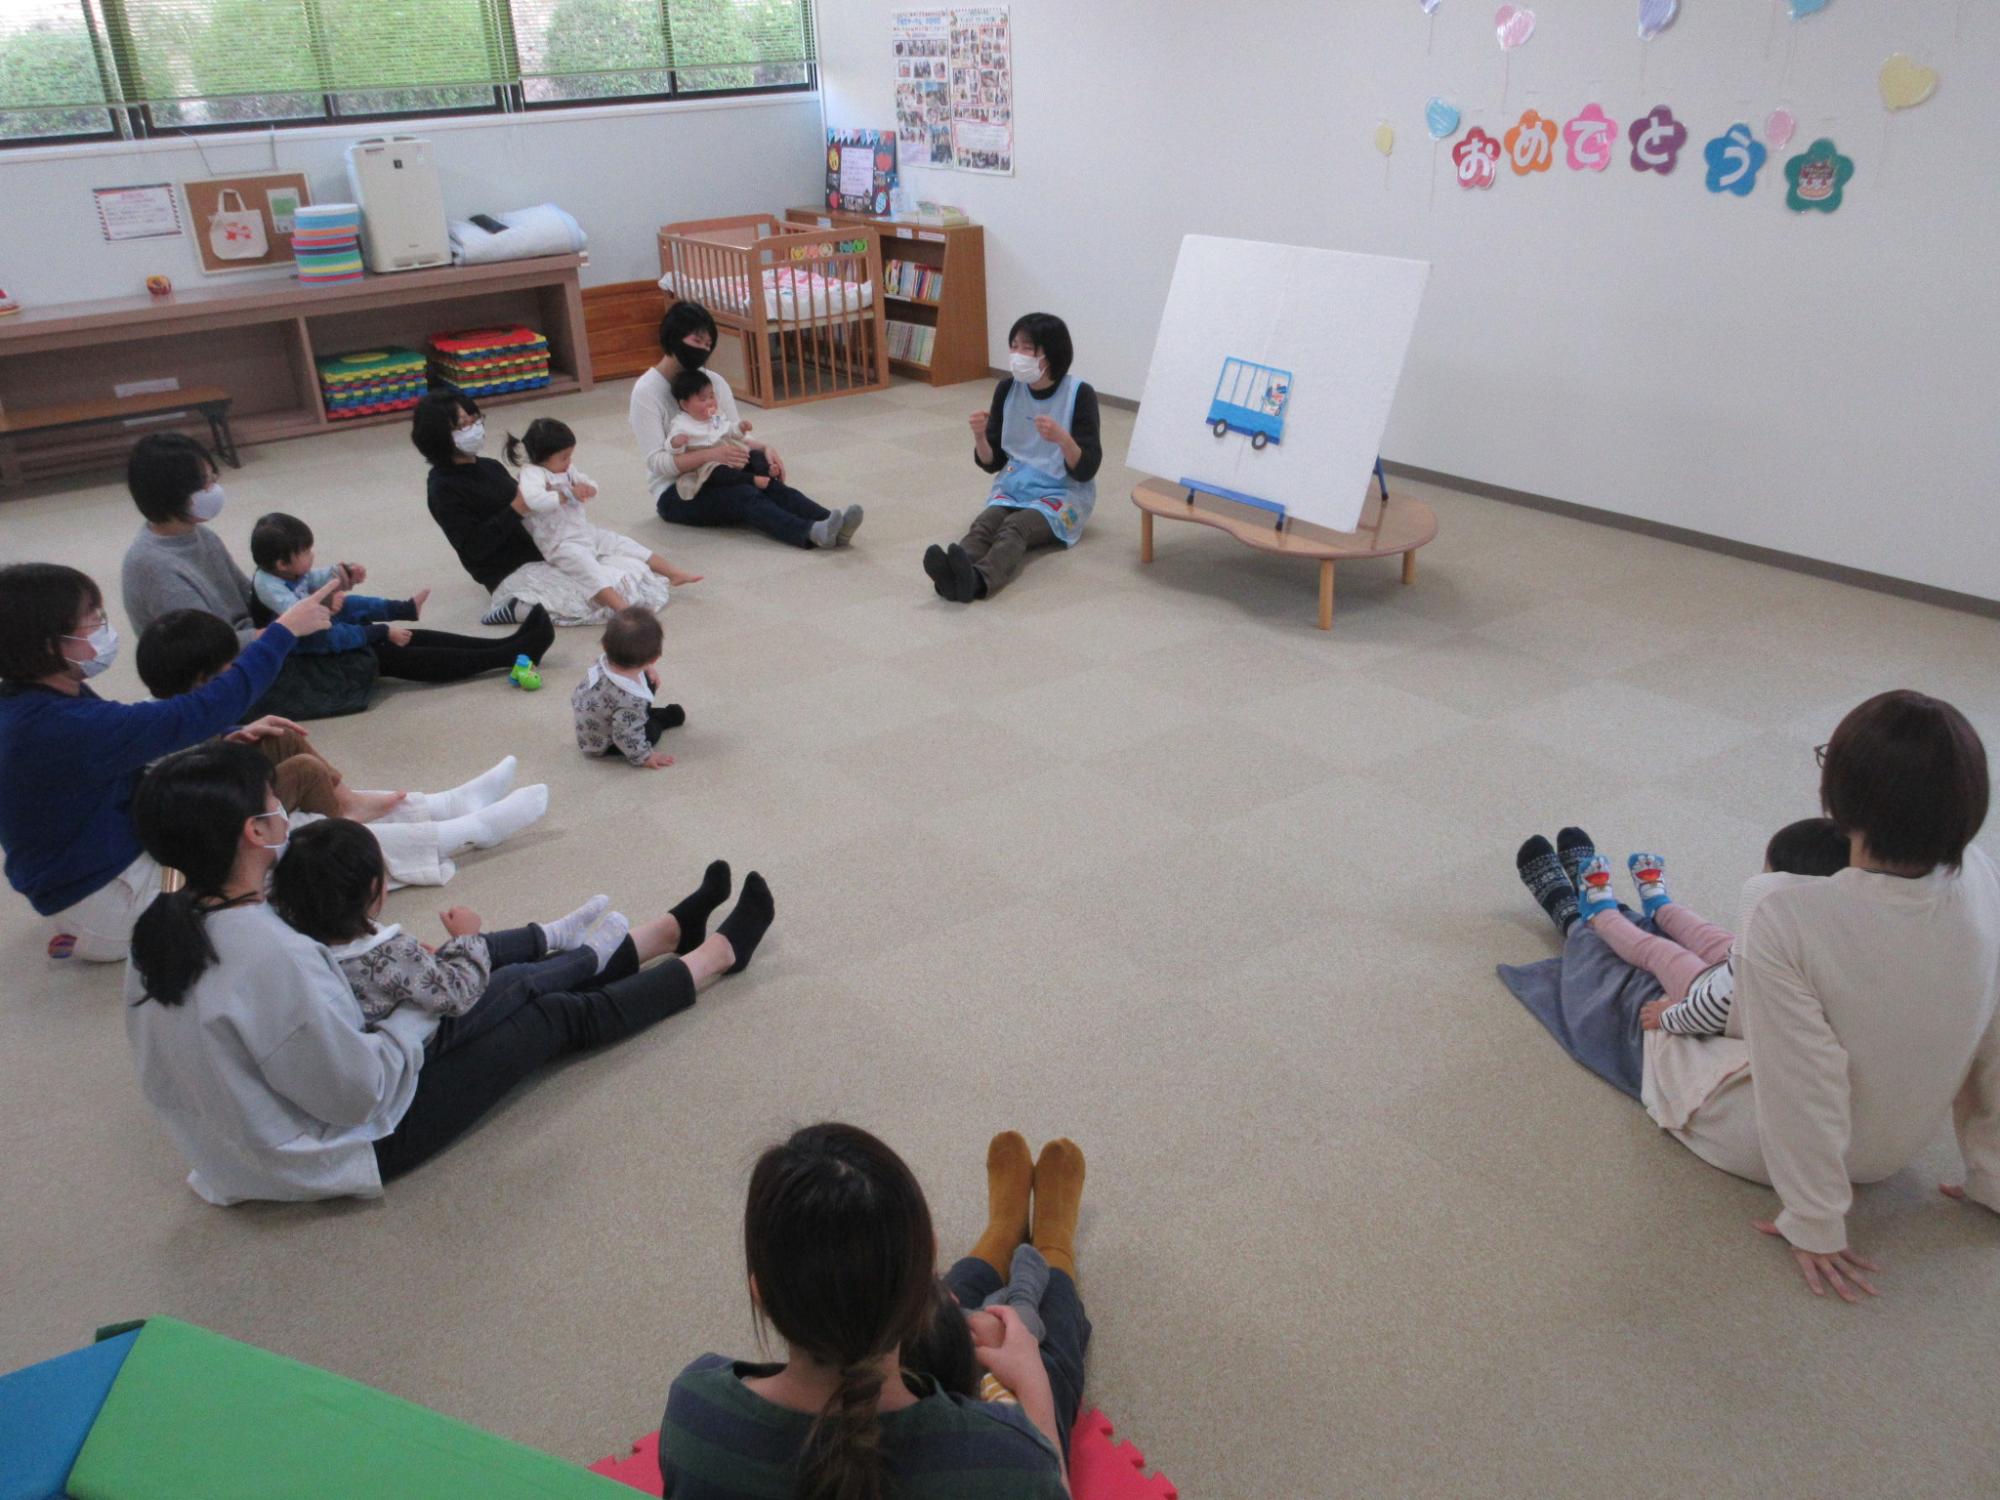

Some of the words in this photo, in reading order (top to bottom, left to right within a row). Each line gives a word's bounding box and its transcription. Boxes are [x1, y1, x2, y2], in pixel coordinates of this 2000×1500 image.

[1459, 119, 1753, 187] おめでとう
